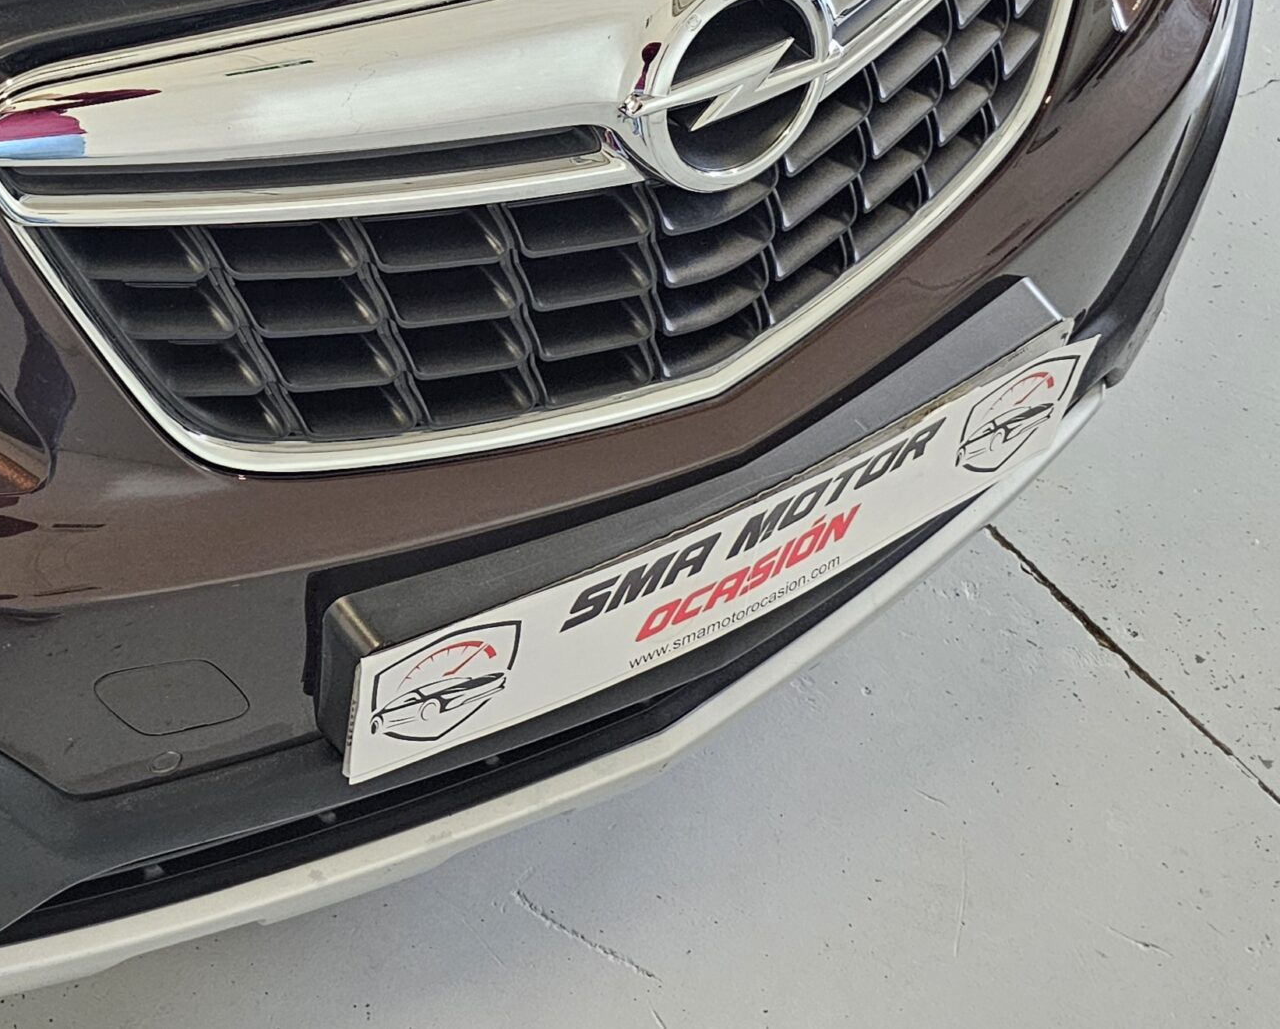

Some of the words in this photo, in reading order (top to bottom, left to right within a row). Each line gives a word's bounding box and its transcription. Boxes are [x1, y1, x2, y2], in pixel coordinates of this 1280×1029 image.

[559, 531, 722, 633] SMA
[726, 416, 947, 560] MOTOR
[634, 503, 862, 643] OCASIÓN
[628, 555, 841, 670] www.smamotorocasion.com
